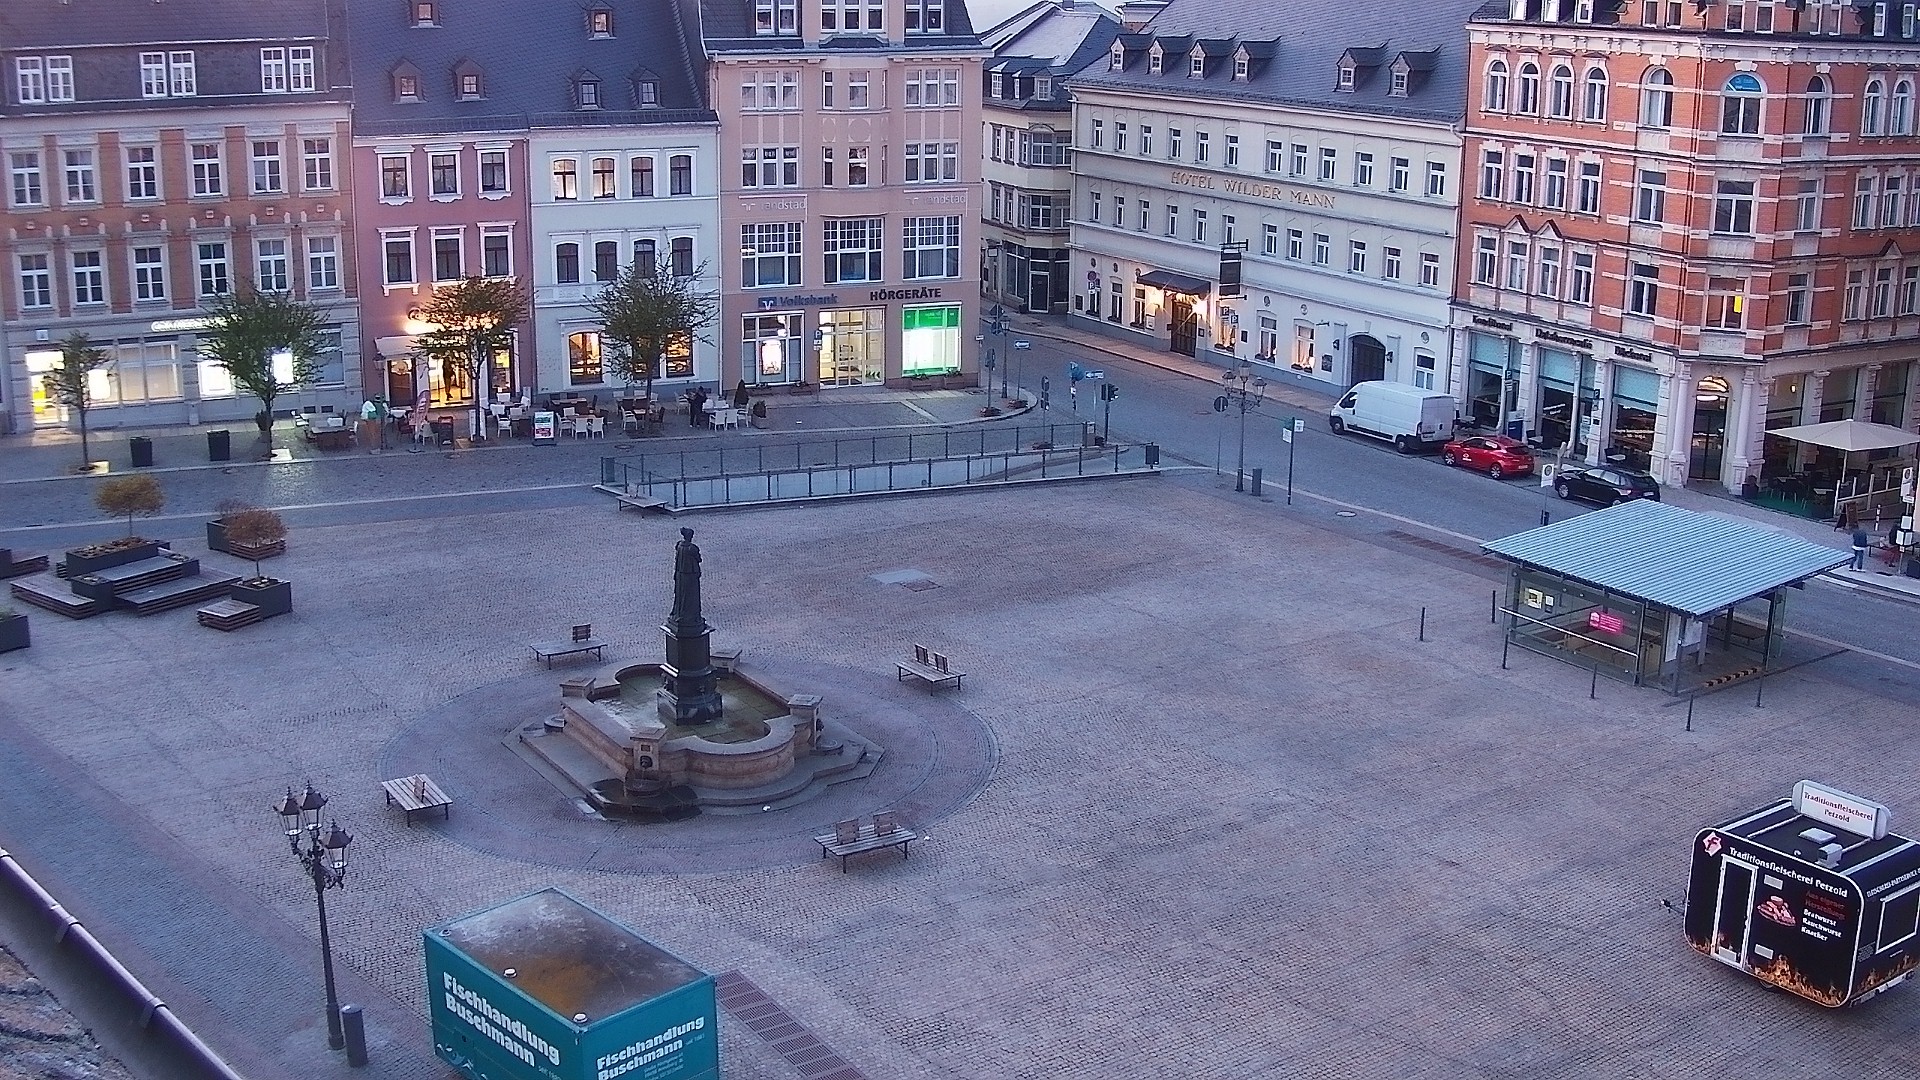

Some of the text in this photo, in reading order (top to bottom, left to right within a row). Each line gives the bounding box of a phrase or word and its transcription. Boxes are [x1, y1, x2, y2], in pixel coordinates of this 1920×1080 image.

[1171, 171, 1336, 210] HOTEL WILDER MANN
[779, 292, 838, 307] Volksbank
[869, 286, 942, 301] HÖRGERÄTE
[1803, 791, 1873, 821] Traditionsfleischerei
[1824, 808, 1851, 823] Petzold
[1729, 846, 1849, 898] Traditionsfleischerei Petzold
[1802, 917, 1842, 938] Rauchwurst
[1803, 908, 1837, 927] Bratwurst
[1801, 926, 1828, 942] Knacker
[443, 971, 560, 1066] Fischhandlung
[445, 992, 535, 1067] Buschmann
[597, 1016, 705, 1070] Fischhandlung
[598, 1039, 683, 1080] Buschmann
